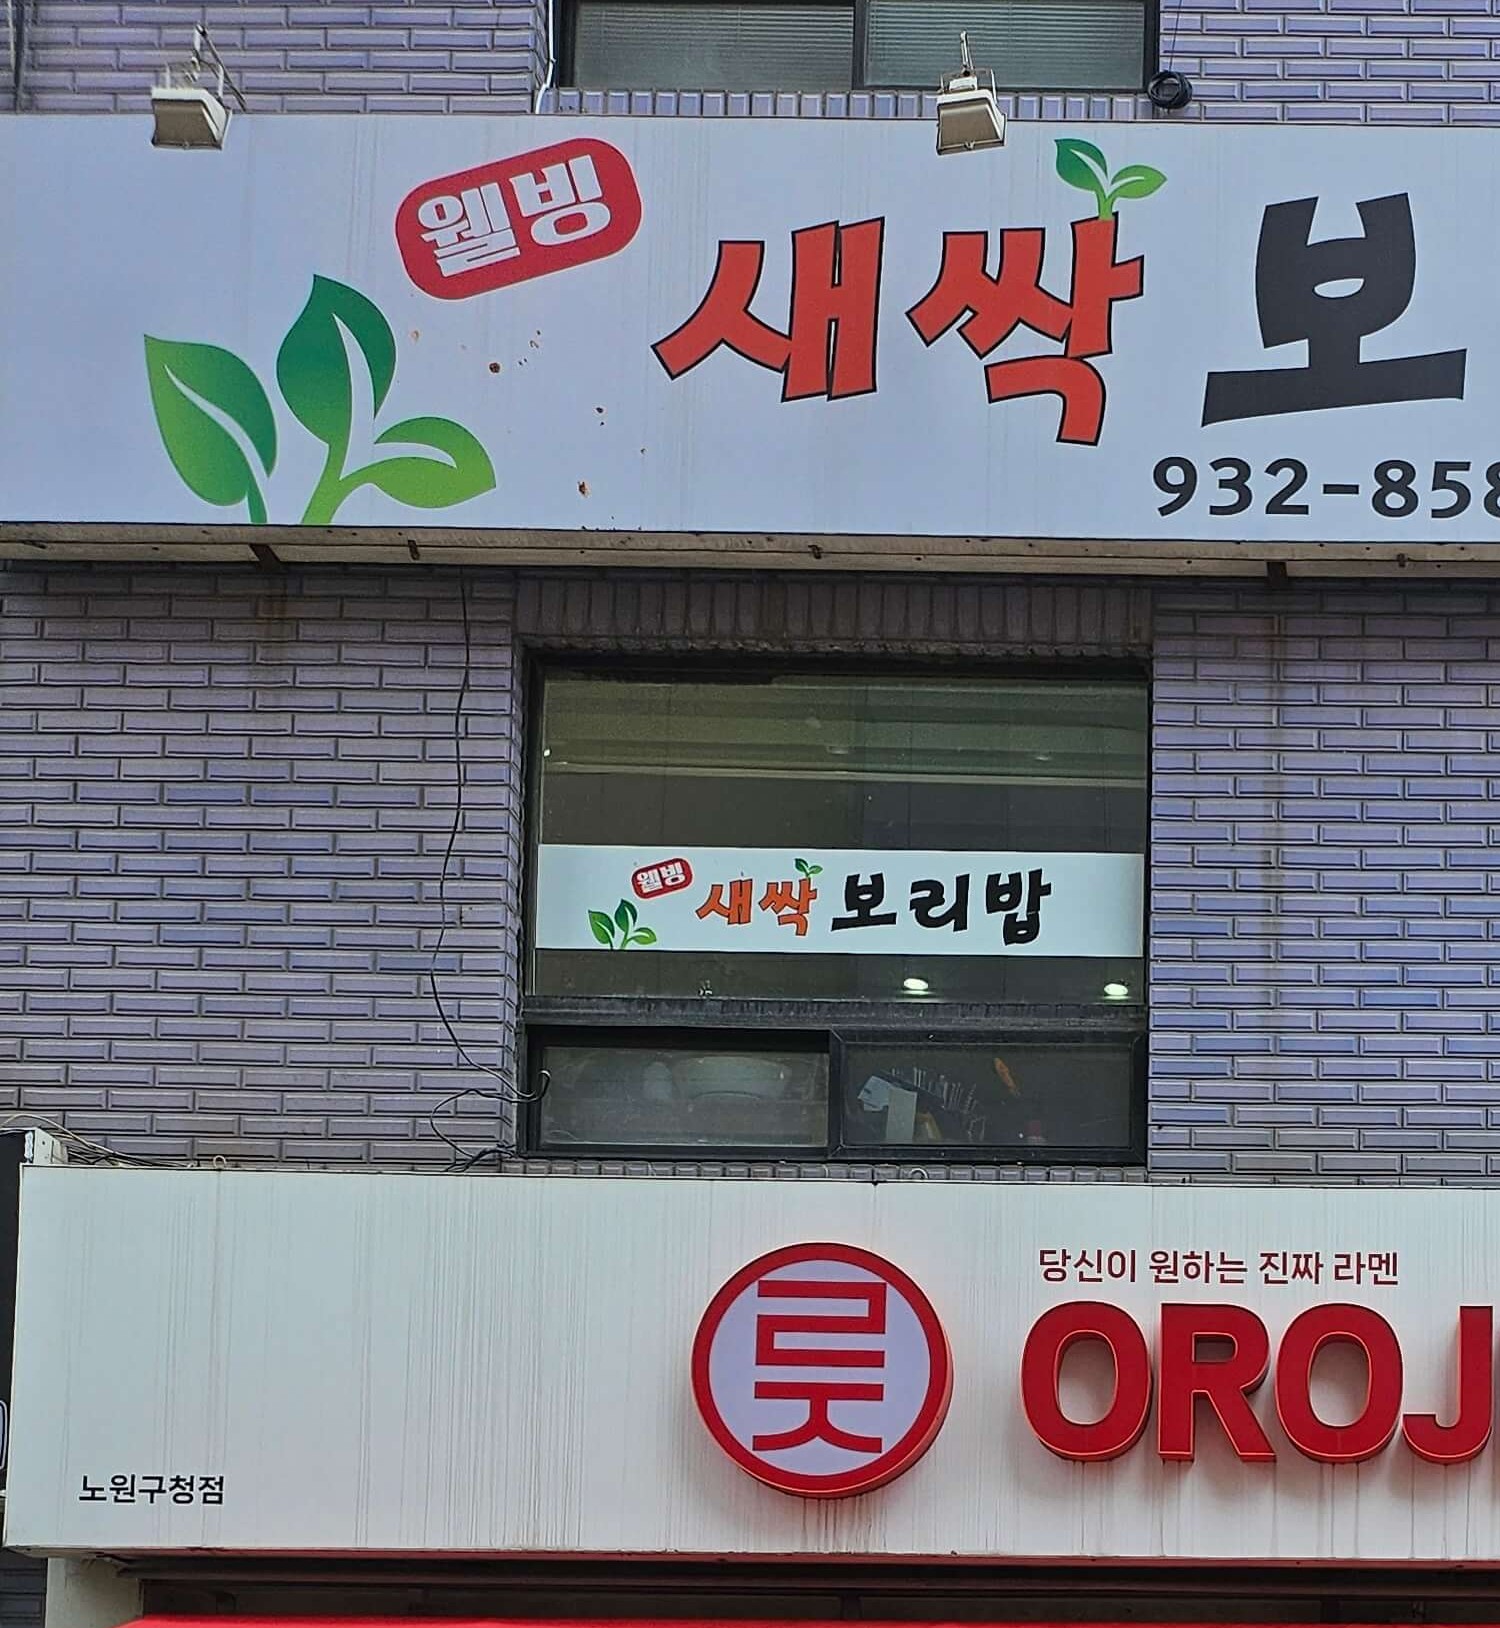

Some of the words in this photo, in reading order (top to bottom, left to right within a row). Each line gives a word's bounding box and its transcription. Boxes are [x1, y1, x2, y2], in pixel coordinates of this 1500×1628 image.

[416, 153, 612, 278] 웰빙
[651, 210, 1145, 447] 새싹
[636, 861, 686, 892] 웰빙
[696, 877, 818, 937] 새싹
[830, 867, 1053, 946] 보리밥
[1038, 1248, 1137, 1284] 당신이
[1148, 1249, 1249, 1285] 원하는
[1257, 1250, 1325, 1286] 진짜
[1333, 1251, 1400, 1287] 라멘
[78, 1473, 226, 1506] 노원구청점
